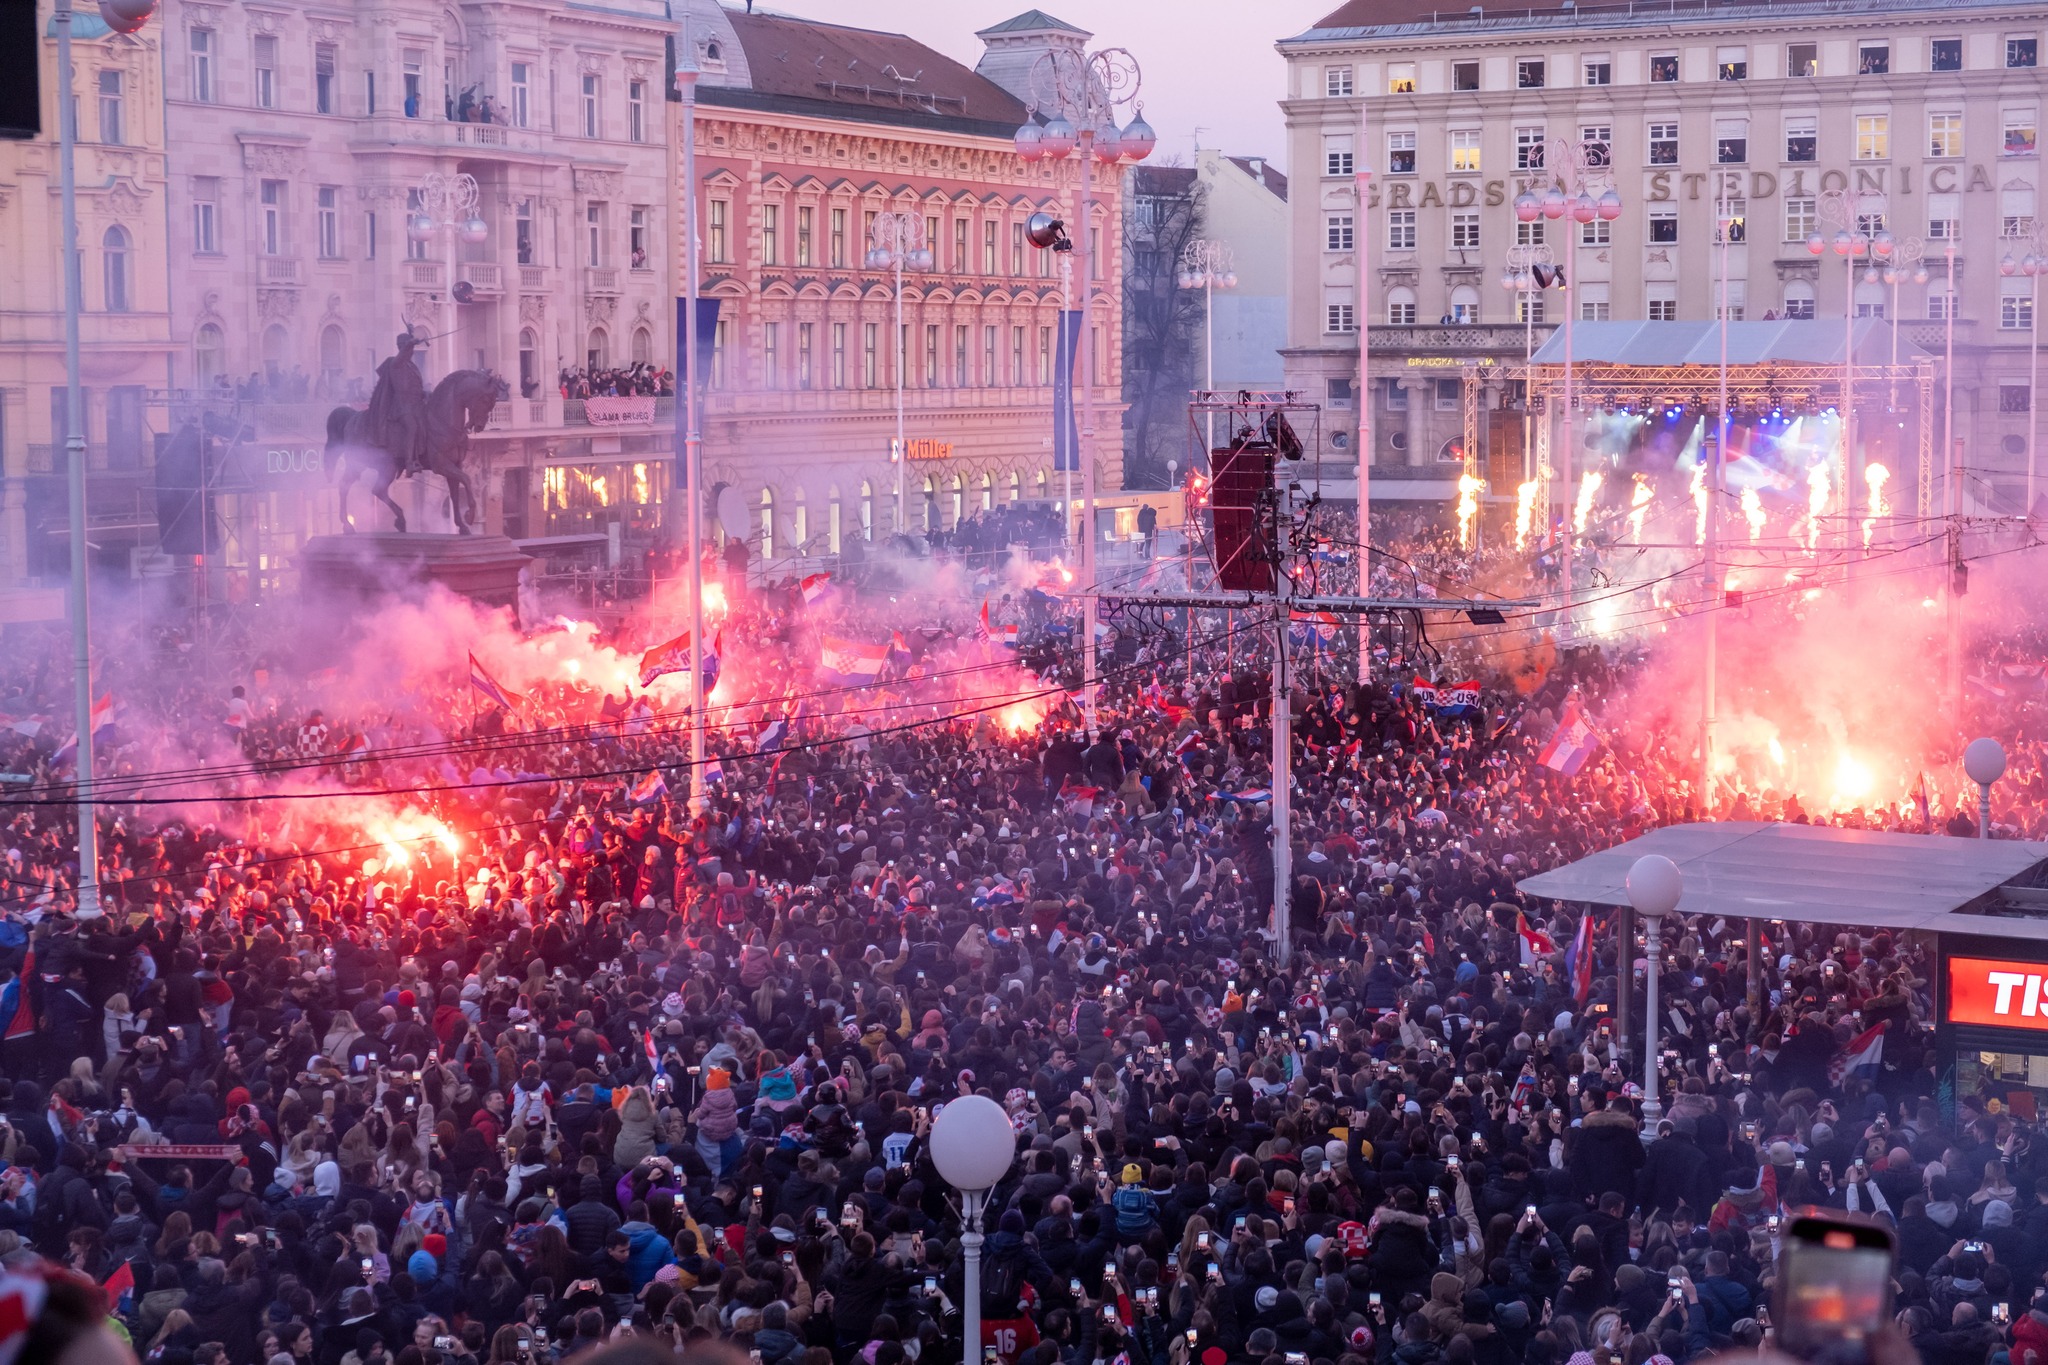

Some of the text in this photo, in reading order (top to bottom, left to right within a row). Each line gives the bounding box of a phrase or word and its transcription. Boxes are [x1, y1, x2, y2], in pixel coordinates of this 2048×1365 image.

[1354, 164, 1995, 209] GRADS ŠTEDIONICA
[906, 438, 954, 460] Müller
[1987, 971, 2048, 1018] TI
[993, 1328, 1017, 1354] 16
